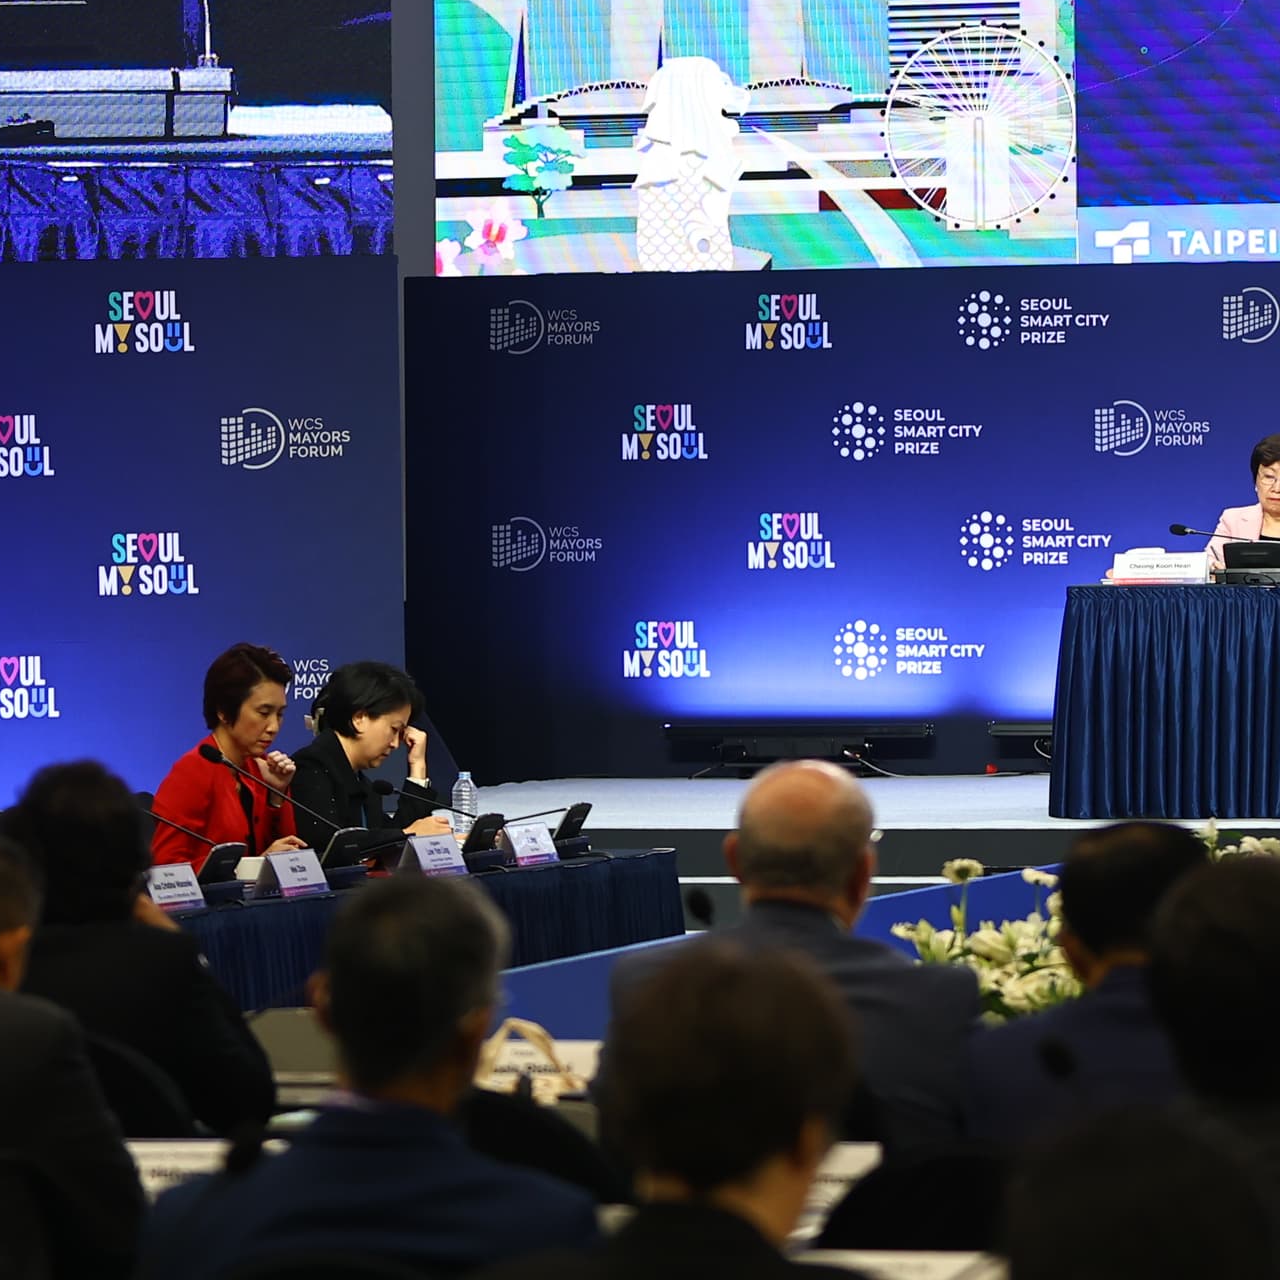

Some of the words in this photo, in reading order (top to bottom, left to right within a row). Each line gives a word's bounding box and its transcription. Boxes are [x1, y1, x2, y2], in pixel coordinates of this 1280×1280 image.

[1167, 229, 1277, 256] TAIPEI
[1021, 298, 1072, 310] SEOUL
[548, 310, 577, 320] WCS
[1021, 315, 1072, 327] SMART
[1075, 314, 1109, 326] CITY
[548, 321, 600, 333] MAYORS
[548, 334, 593, 345] FORUM
[780, 322, 832, 349] SOUL
[1021, 331, 1065, 343] PRIZE
[894, 409, 945, 421] SEOUL
[1154, 410, 1185, 421] WCS
[288, 418, 323, 430] WCS
[1155, 422, 1210, 433] MAYORS
[894, 426, 946, 437] SMART
[948, 425, 982, 437] CITY
[289, 431, 350, 444] MAYORS
[1155, 435, 1202, 446] FORUM
[290, 445, 342, 458] FORUM
[895, 442, 939, 454] PRIZE
[1023, 519, 1074, 531] SEOUL
[549, 527, 579, 537] WCS
[550, 538, 602, 549] MAYORS
[1023, 535, 1075, 548] SMART
[1077, 535, 1111, 547] CITY
[550, 551, 595, 562] FORUM
[783, 541, 835, 569] SOUL
[1023, 552, 1068, 564] PRIZE
[896, 628, 947, 641] SEOUL
[896, 644, 948, 657] SMART
[950, 645, 984, 657] CITY
[293, 659, 329, 672] WCS
[896, 661, 942, 674] PRIZE
[0, 688, 60, 719] SOUL
